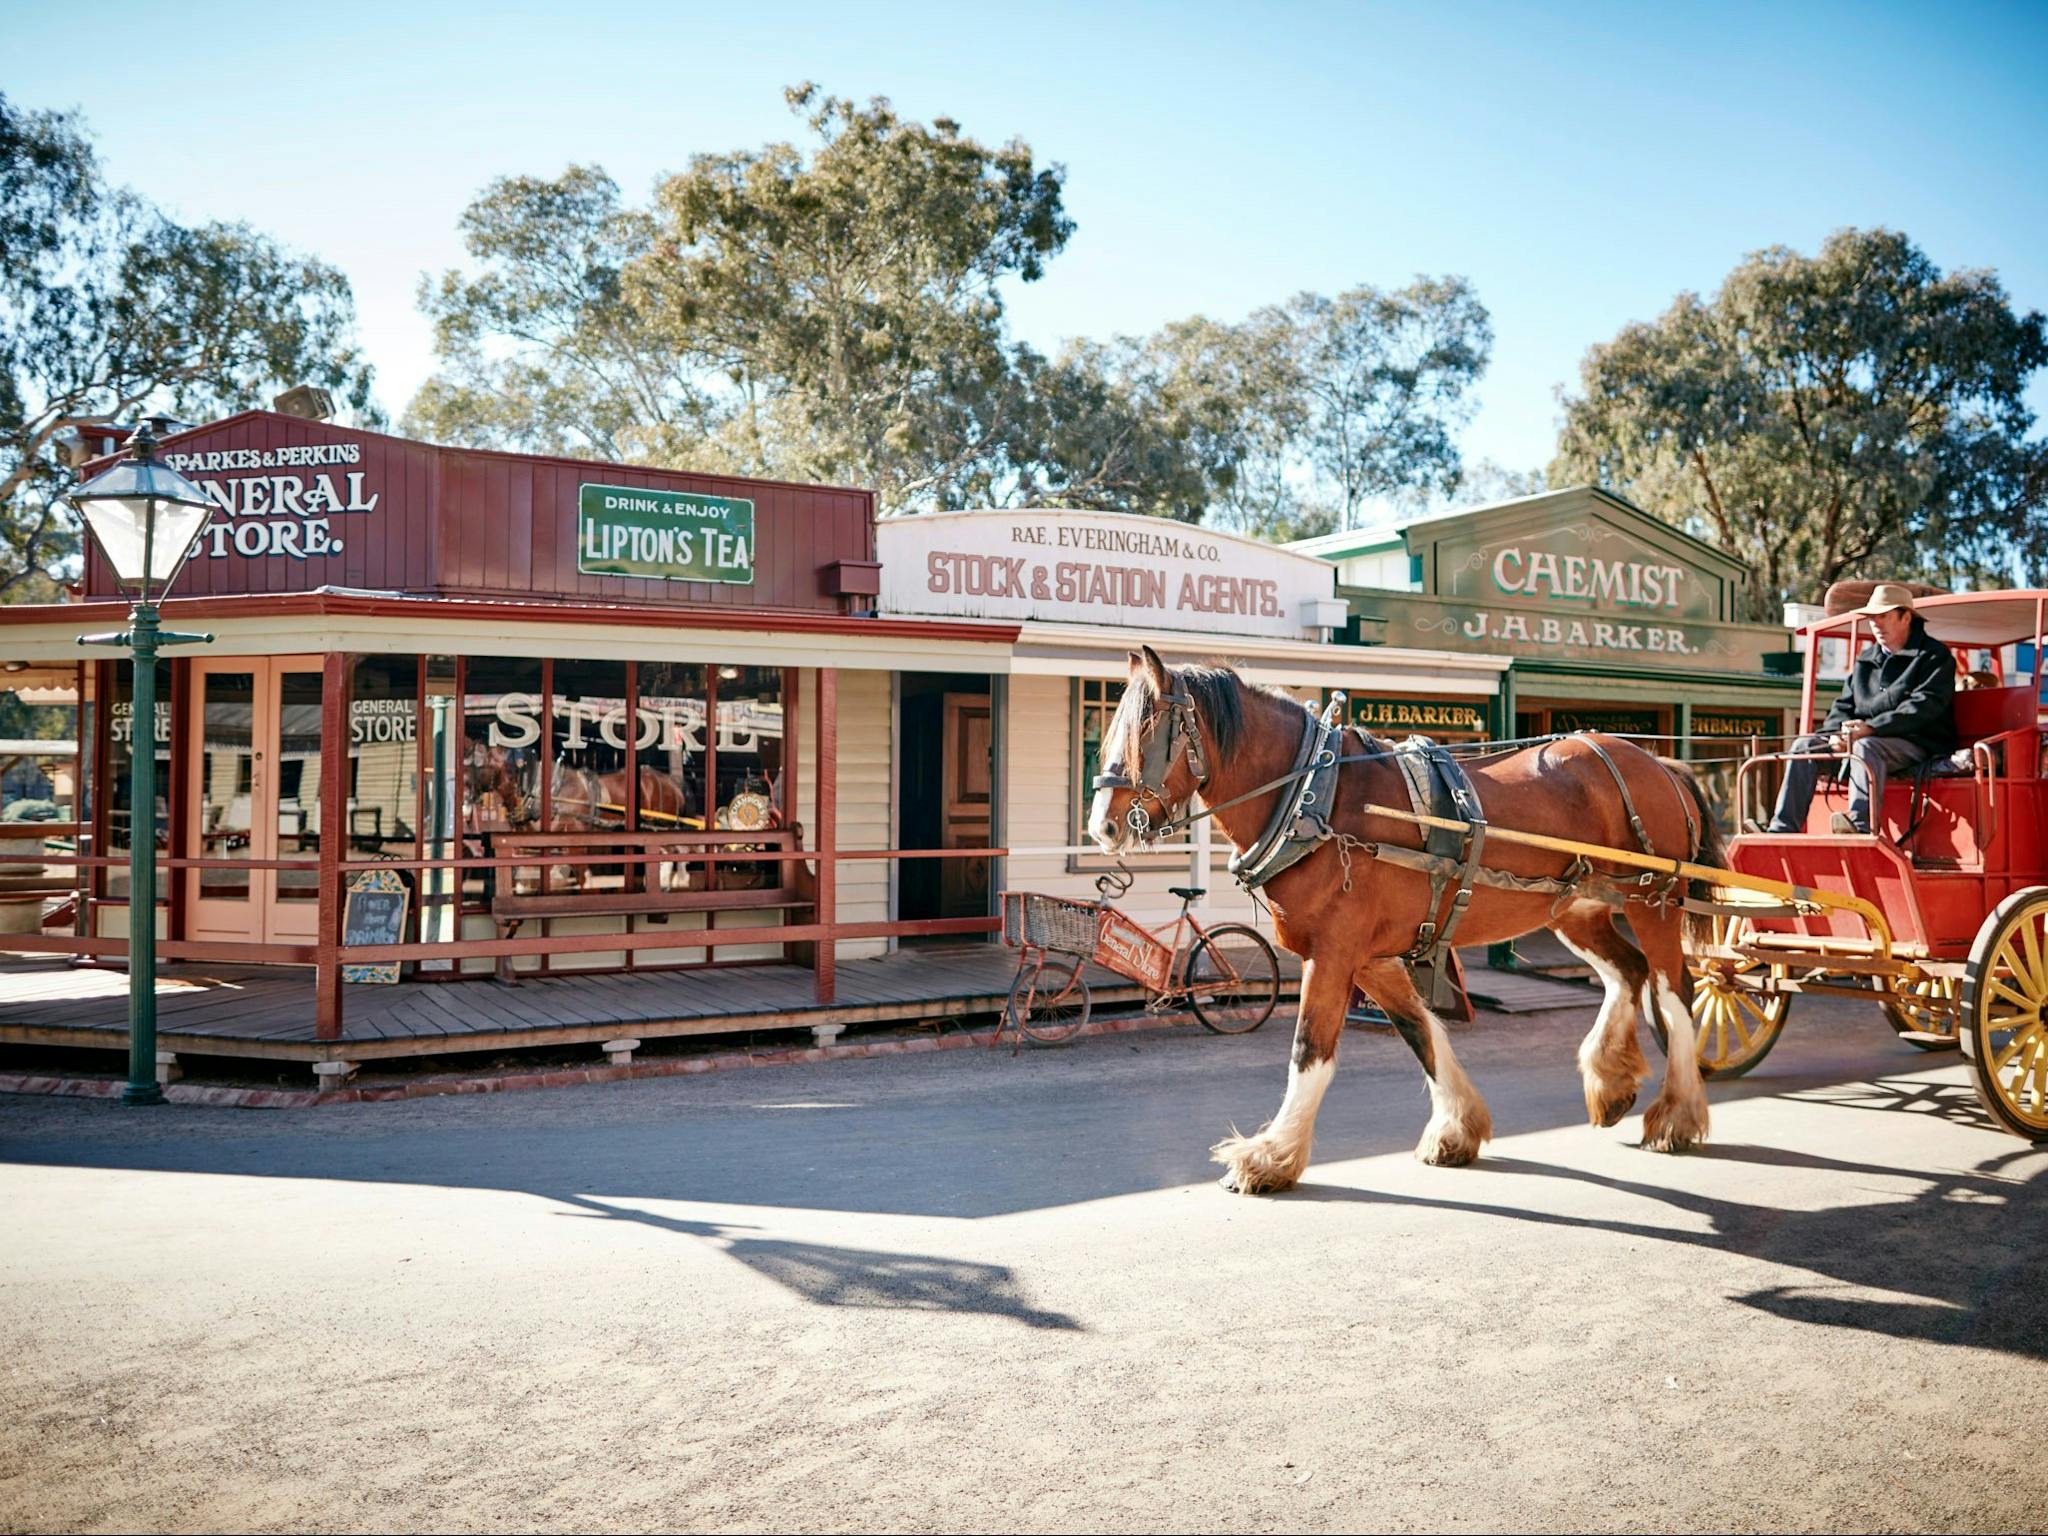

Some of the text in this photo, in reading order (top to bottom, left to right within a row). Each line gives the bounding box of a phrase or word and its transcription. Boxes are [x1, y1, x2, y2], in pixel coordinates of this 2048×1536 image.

[164, 449, 261, 472] SPARKES
[275, 444, 360, 467] PERKINS
[191, 472, 379, 517] NERAL
[605, 496, 730, 519] DRINK & ENJOY
[188, 518, 344, 558] TORE.
[586, 517, 749, 569] LIPTON'S TEA
[1057, 526, 1179, 558] EVERINGHAM
[1182, 543, 1194, 559] &
[1198, 544, 1222, 563] CO.
[927, 551, 1286, 618] STOCK & STATION AGENTS.
[1491, 547, 1684, 607] CHEMIST
[352, 699, 413, 714] GENERAL
[489, 692, 759, 753] STORE
[351, 715, 416, 742] STORE
[1100, 916, 1160, 980] General Store
